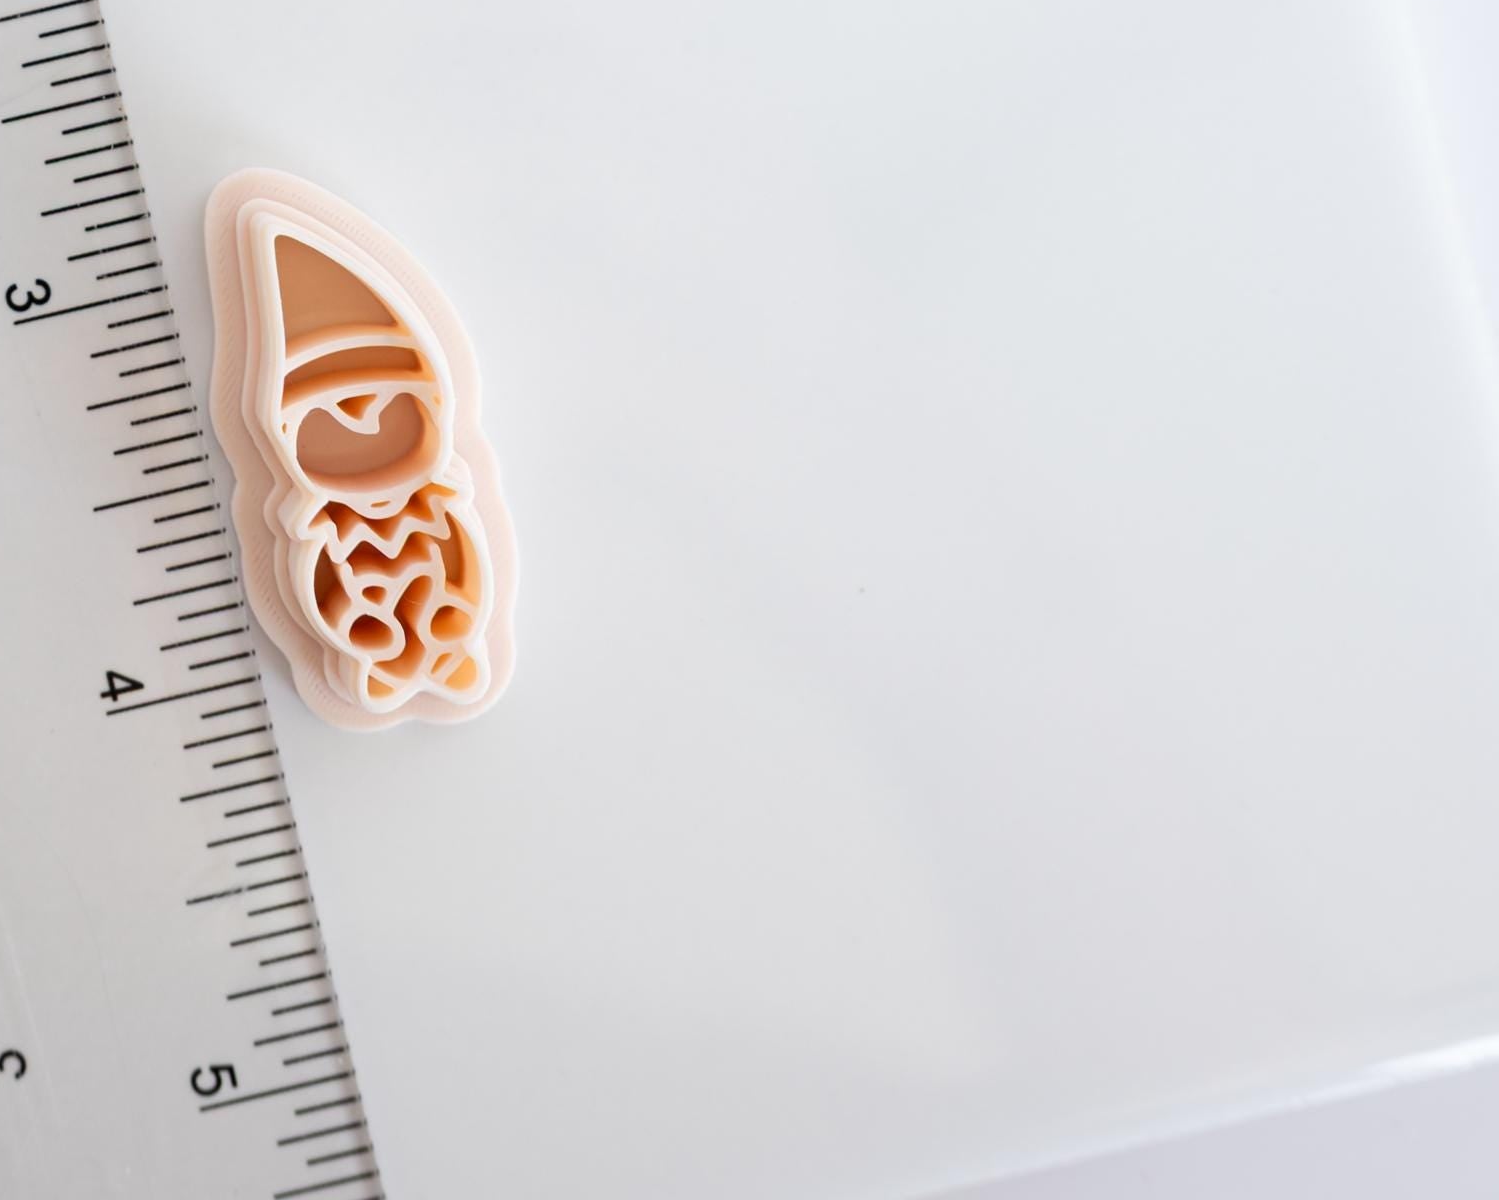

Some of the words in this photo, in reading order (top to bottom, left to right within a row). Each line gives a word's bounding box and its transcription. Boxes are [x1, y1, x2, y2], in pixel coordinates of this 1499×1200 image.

[4, 277, 53, 314] 3
[99, 669, 145, 703] 4
[189, 1063, 239, 1099] 5
